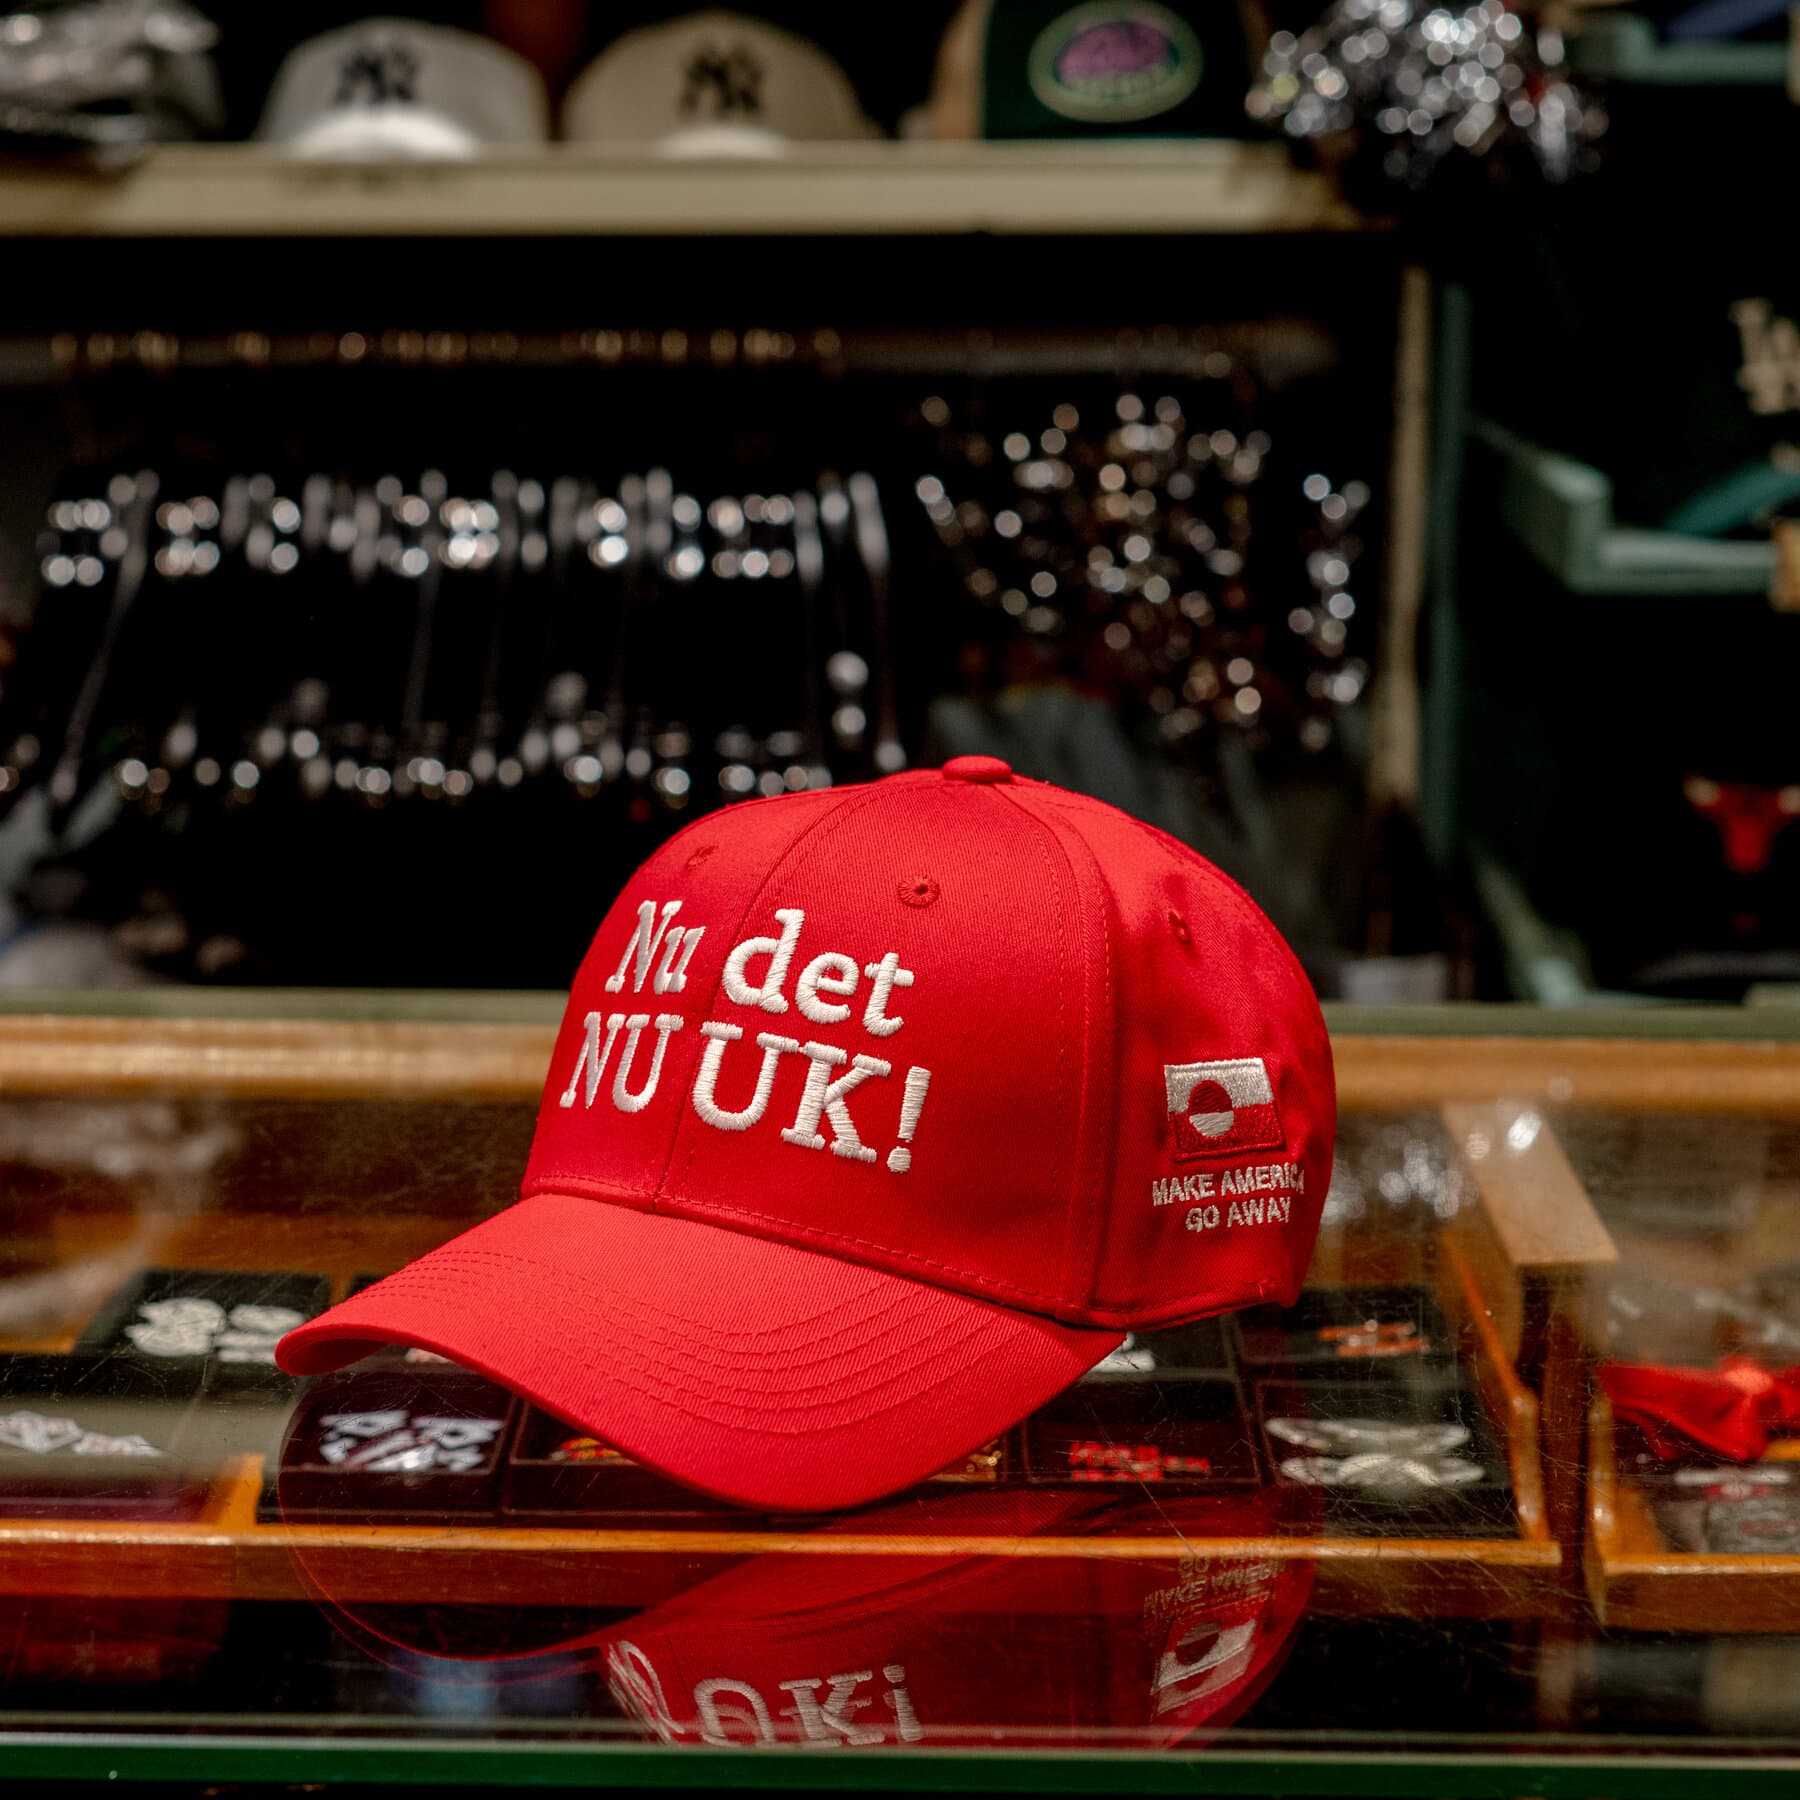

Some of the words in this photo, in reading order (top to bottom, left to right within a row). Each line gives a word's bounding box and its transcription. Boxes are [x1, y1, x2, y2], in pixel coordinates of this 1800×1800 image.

[605, 900, 706, 995] Nu
[722, 908, 915, 1037] det
[1152, 1174, 1215, 1207] MAKE
[1185, 1205, 1220, 1232] GO
[1226, 1197, 1291, 1228] AWAY
